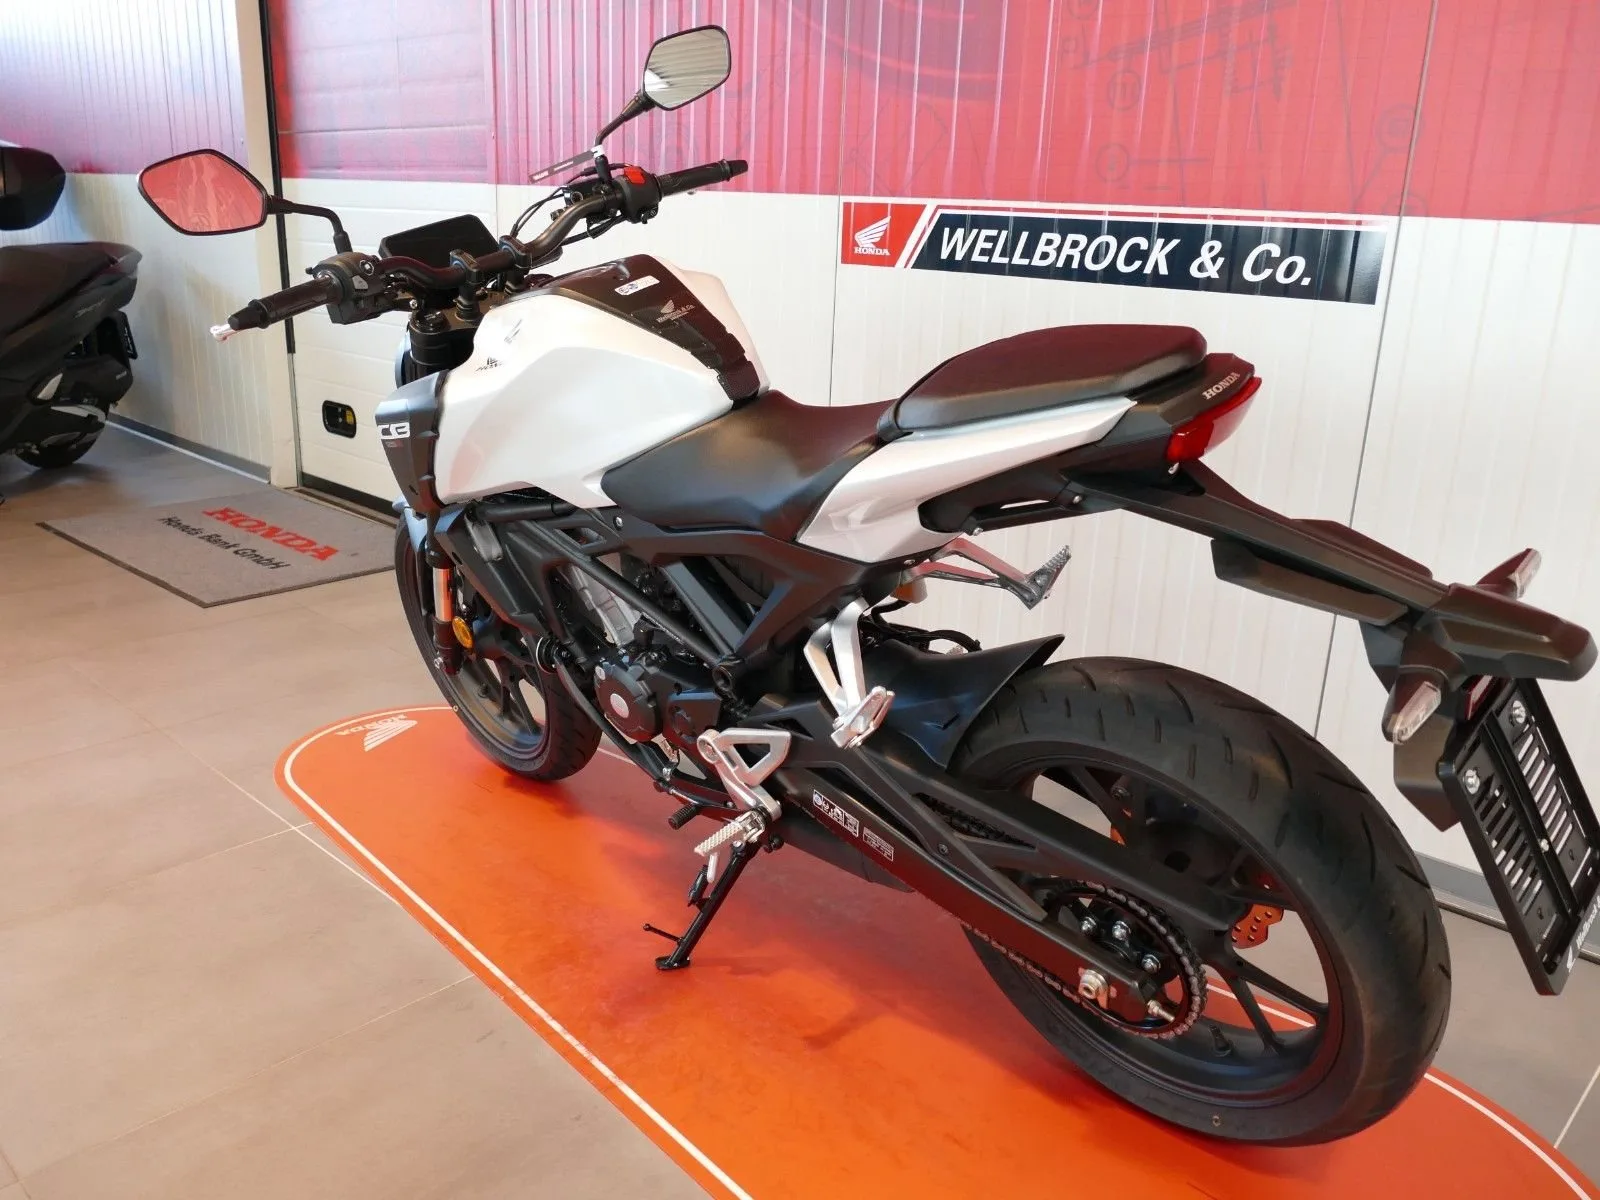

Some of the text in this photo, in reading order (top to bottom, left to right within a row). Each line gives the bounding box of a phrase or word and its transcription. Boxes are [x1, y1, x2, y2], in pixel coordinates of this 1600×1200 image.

[854, 247, 890, 255] HONDA
[940, 227, 1313, 287] WELLBROCK & Co.
[1202, 372, 1240, 400] HONDA
[202, 507, 339, 561] HONDA
